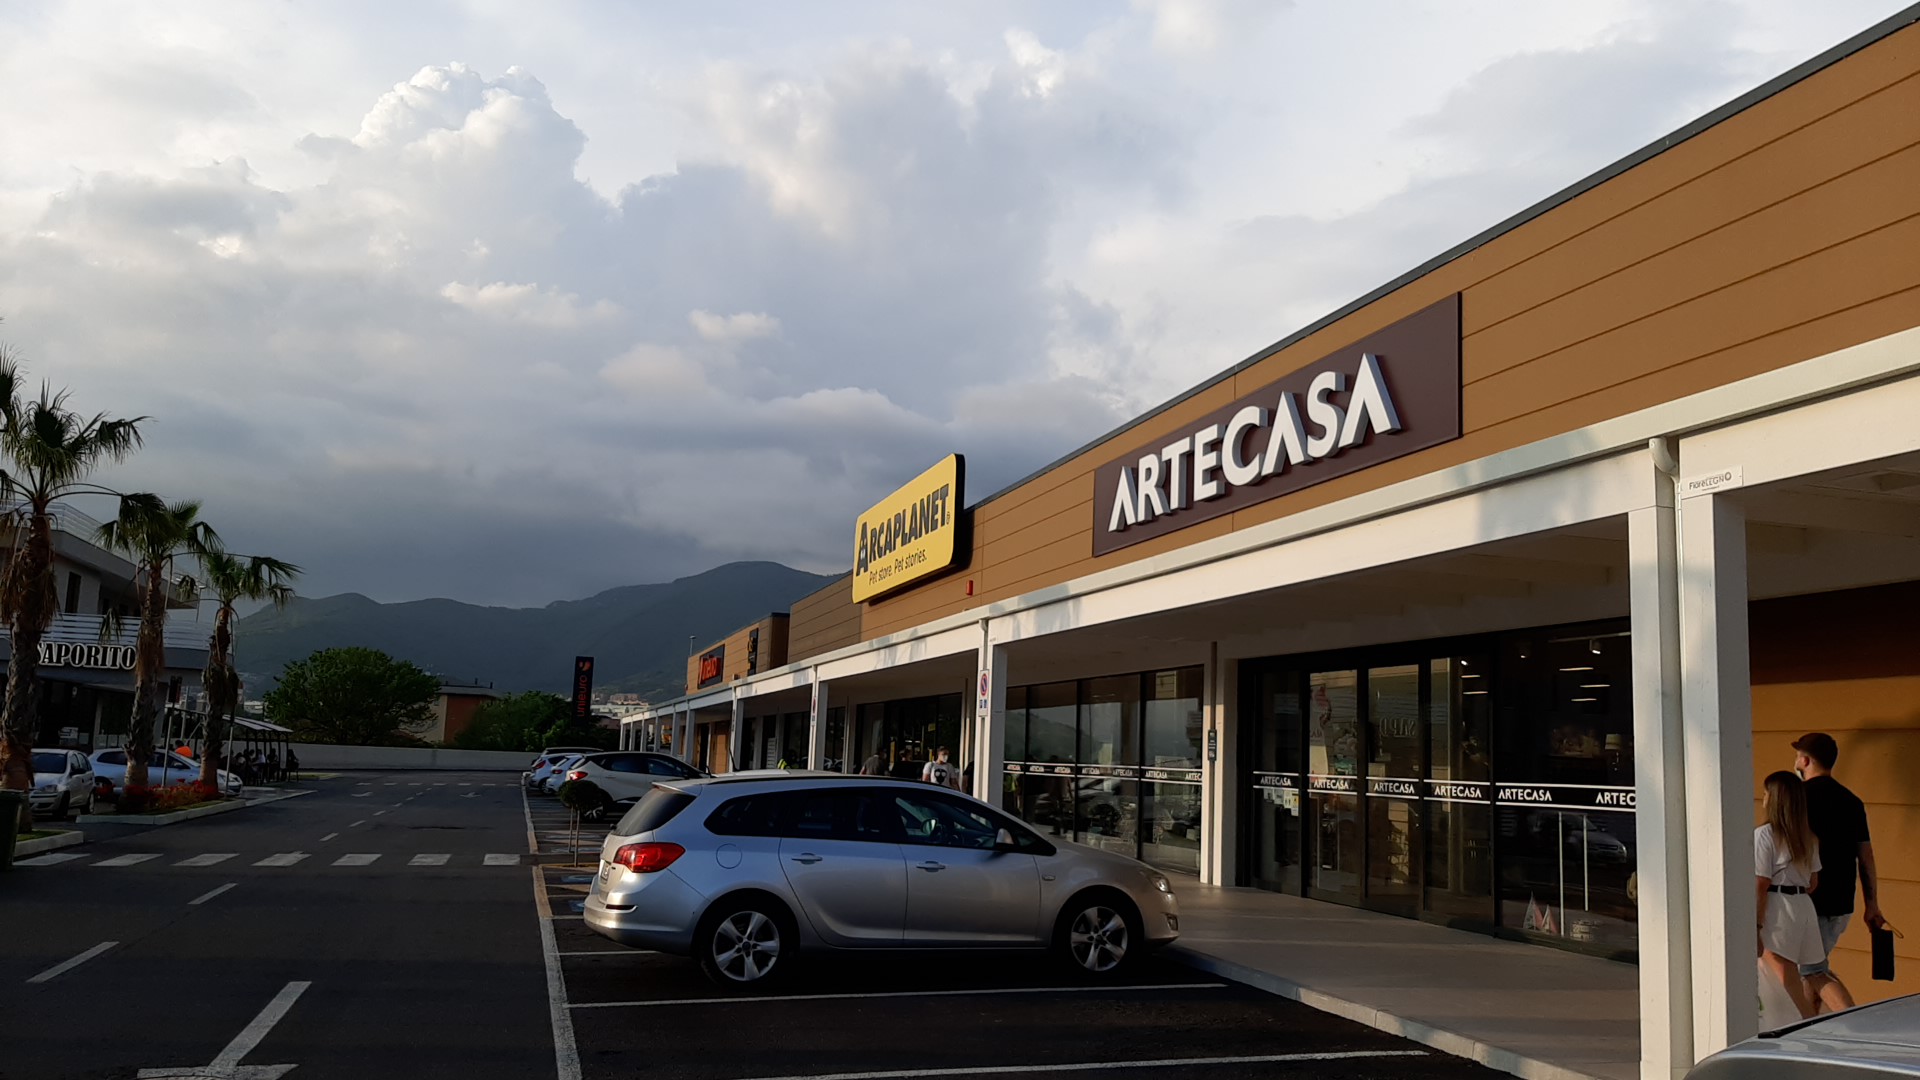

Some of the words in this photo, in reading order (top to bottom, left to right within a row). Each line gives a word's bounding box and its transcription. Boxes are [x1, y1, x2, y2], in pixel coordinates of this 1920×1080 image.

[1108, 353, 1400, 532] ARTECASA
[856, 483, 950, 577] ARCAPLANET
[868, 569, 878, 586] Pet
[878, 565, 893, 581] store.
[894, 555, 905, 574] Pet
[905, 548, 928, 570] stories.
[1260, 776, 1292, 787] ARTECASA
[1313, 778, 1350, 790] ARTECASA
[1373, 781, 1415, 795] ARTECASA
[1434, 785, 1482, 799] ARTECASA
[1498, 788, 1553, 802] ARTECASA
